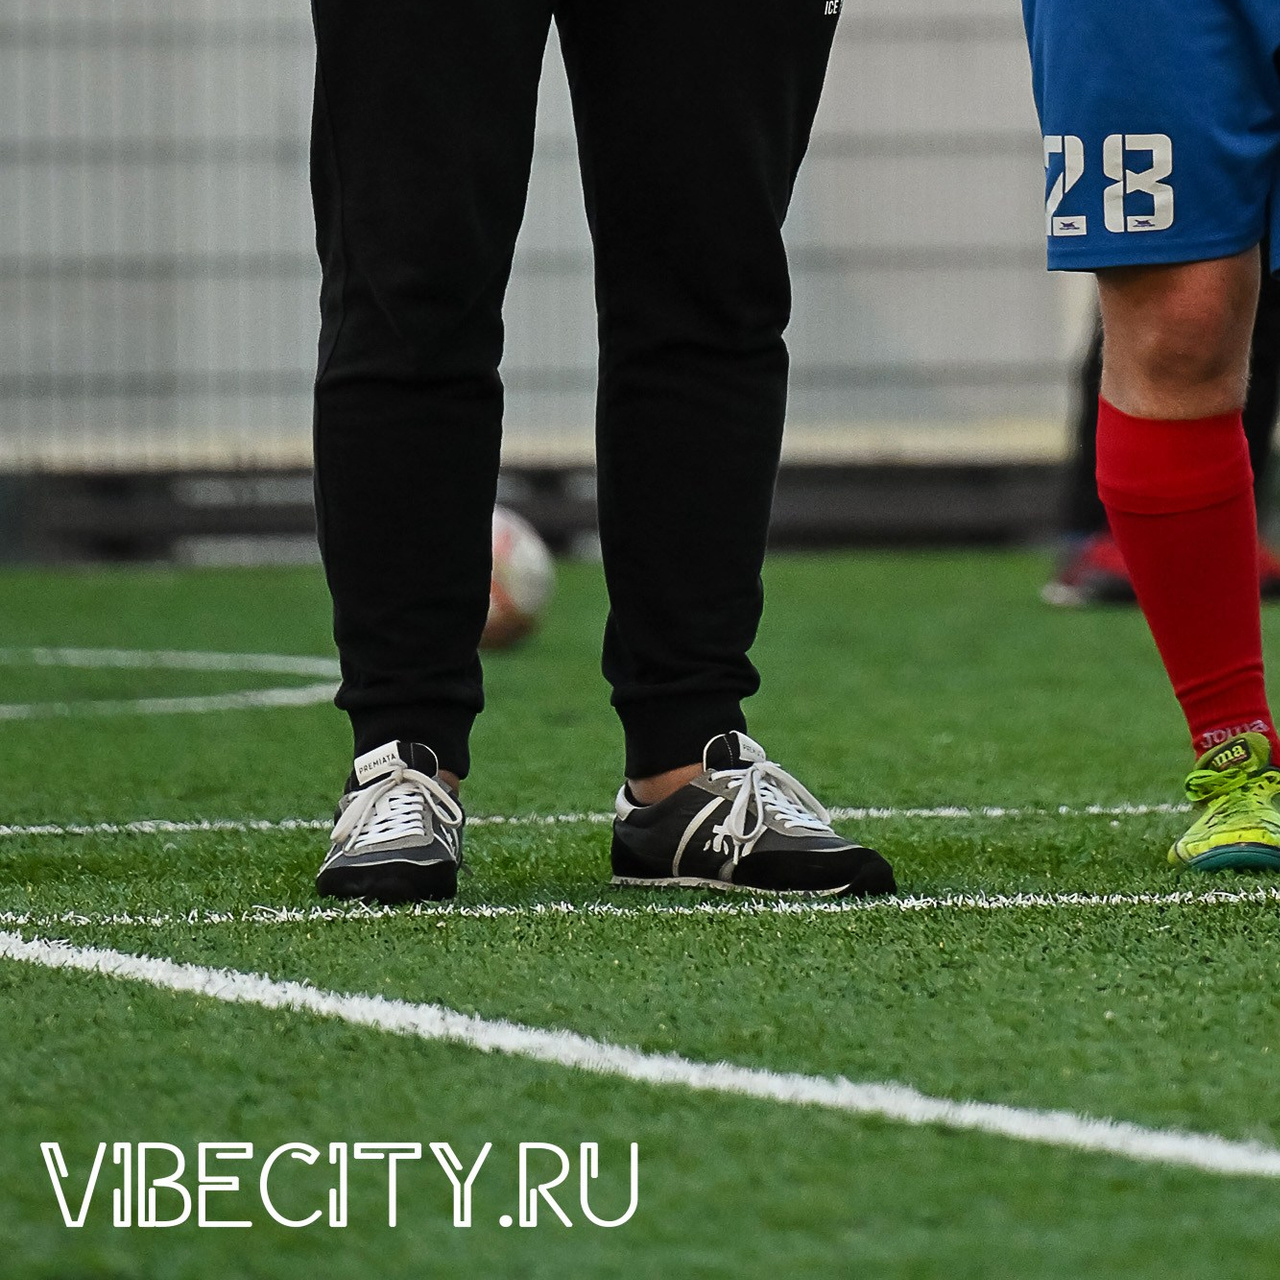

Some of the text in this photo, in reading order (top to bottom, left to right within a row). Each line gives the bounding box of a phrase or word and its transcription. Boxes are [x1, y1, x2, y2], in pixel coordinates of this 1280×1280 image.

[1043, 133, 1175, 237] 28
[358, 752, 397, 775] PREMIATA
[1211, 744, 1247, 768] ma
